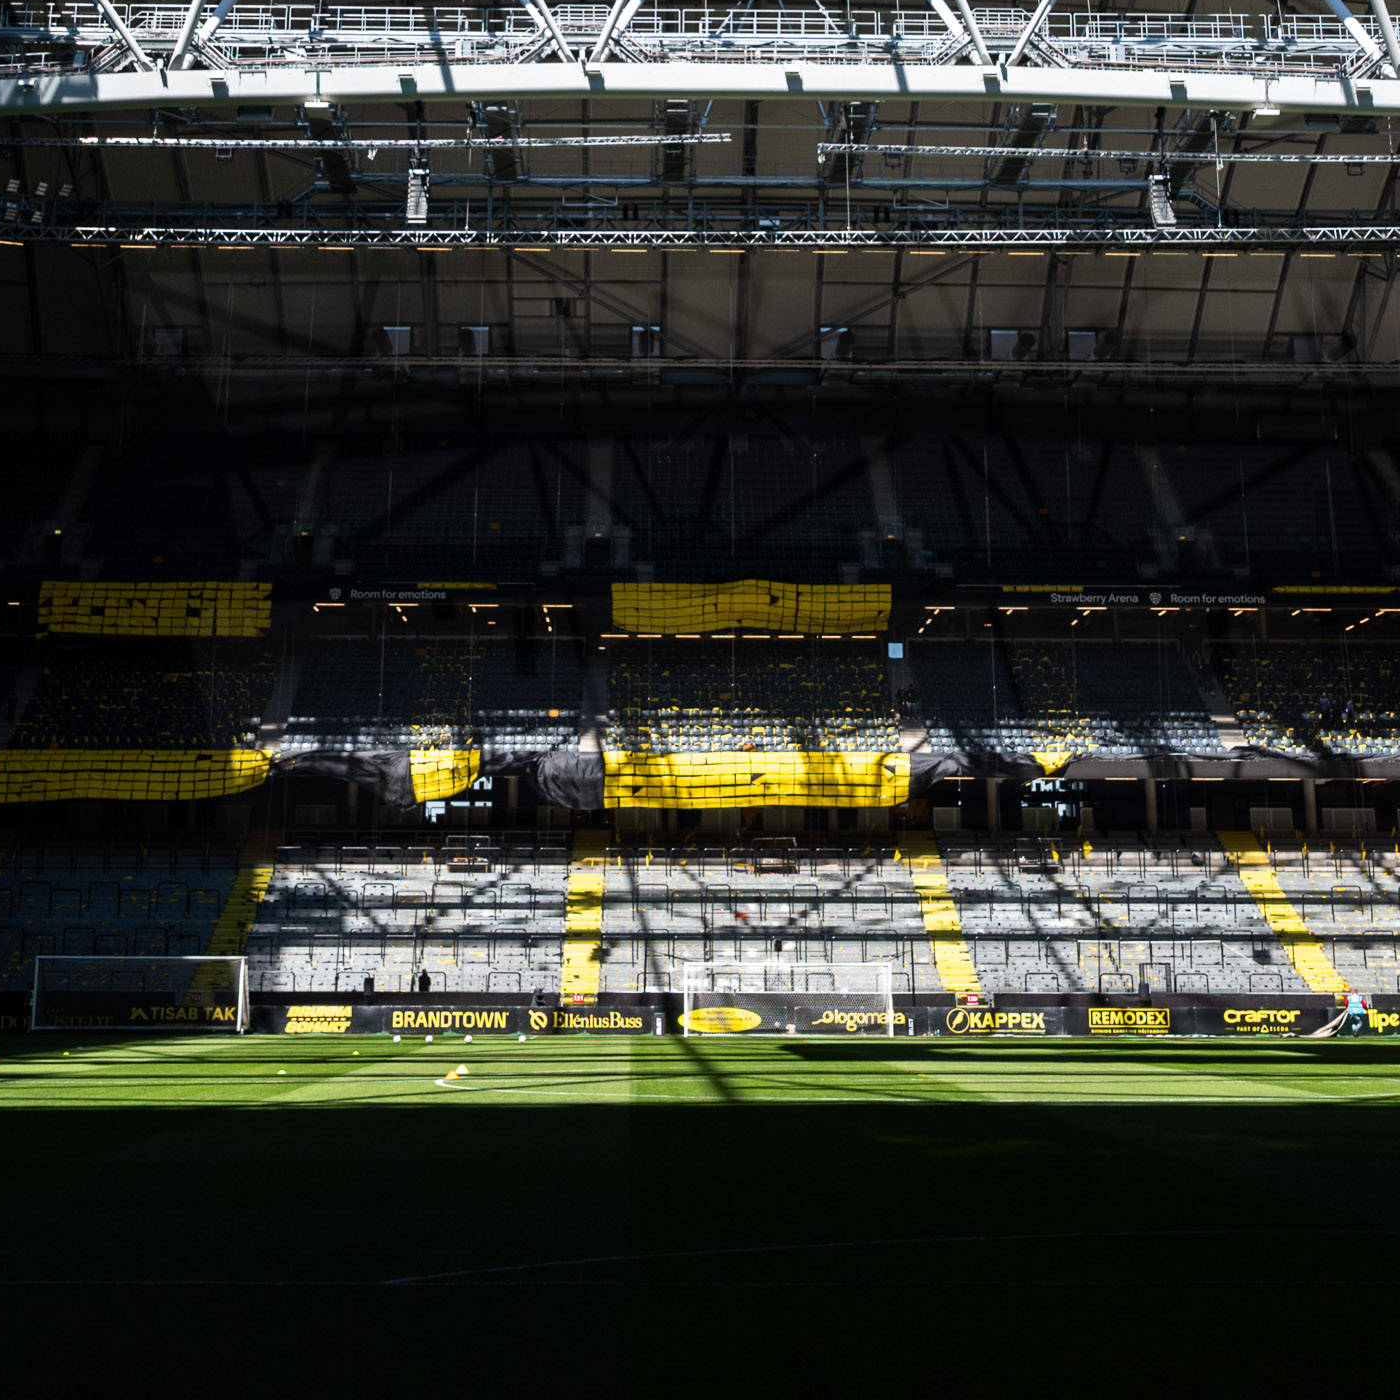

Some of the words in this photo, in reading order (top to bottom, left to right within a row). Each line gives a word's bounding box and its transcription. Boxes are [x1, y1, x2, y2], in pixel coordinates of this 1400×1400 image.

[351, 590, 381, 600] Room
[382, 590, 397, 600] for
[399, 590, 447, 600] emotions
[1050, 593, 1107, 605] Strawberry
[1108, 593, 1138, 603] Arena
[1170, 593, 1201, 604] Room
[1202, 593, 1215, 604] for
[1218, 594, 1266, 604] emotions
[152, 1006, 199, 1021] TISAB
[204, 1006, 236, 1021] TAK
[286, 1005, 353, 1018] BRUNNA
[1092, 1011, 1167, 1026] REMODEX
[392, 1011, 508, 1028] BRANDTOWN
[553, 1011, 643, 1029] ElléniusBuss
[970, 1012, 1046, 1029] KAPPEX
